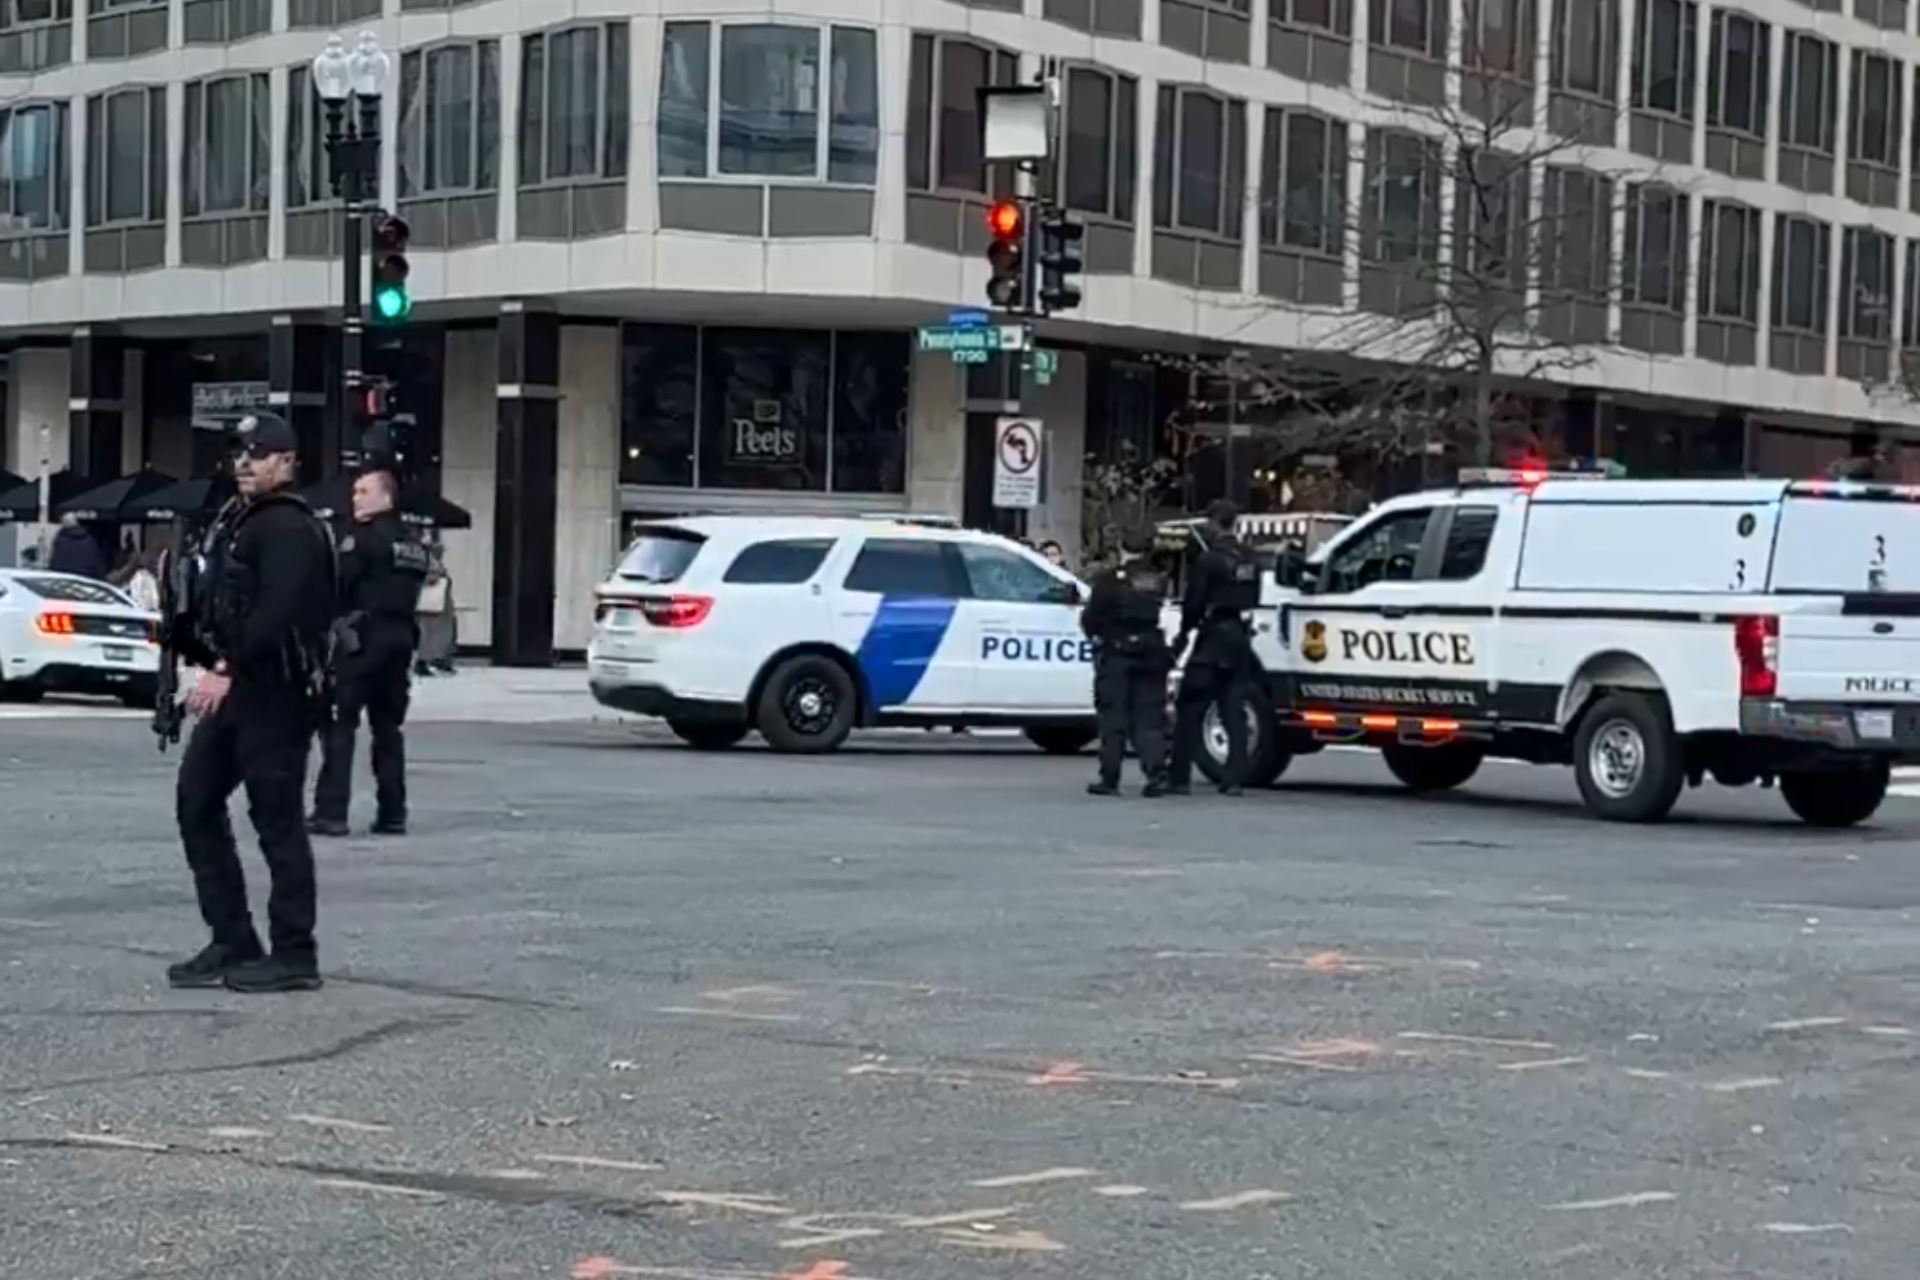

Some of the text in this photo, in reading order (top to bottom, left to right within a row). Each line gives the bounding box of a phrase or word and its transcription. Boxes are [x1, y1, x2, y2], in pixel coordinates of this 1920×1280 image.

[1869, 534, 1886, 566] 3
[1728, 558, 1746, 590] 3
[981, 635, 1094, 663] POLICE
[1341, 628, 1475, 665] POLICE
